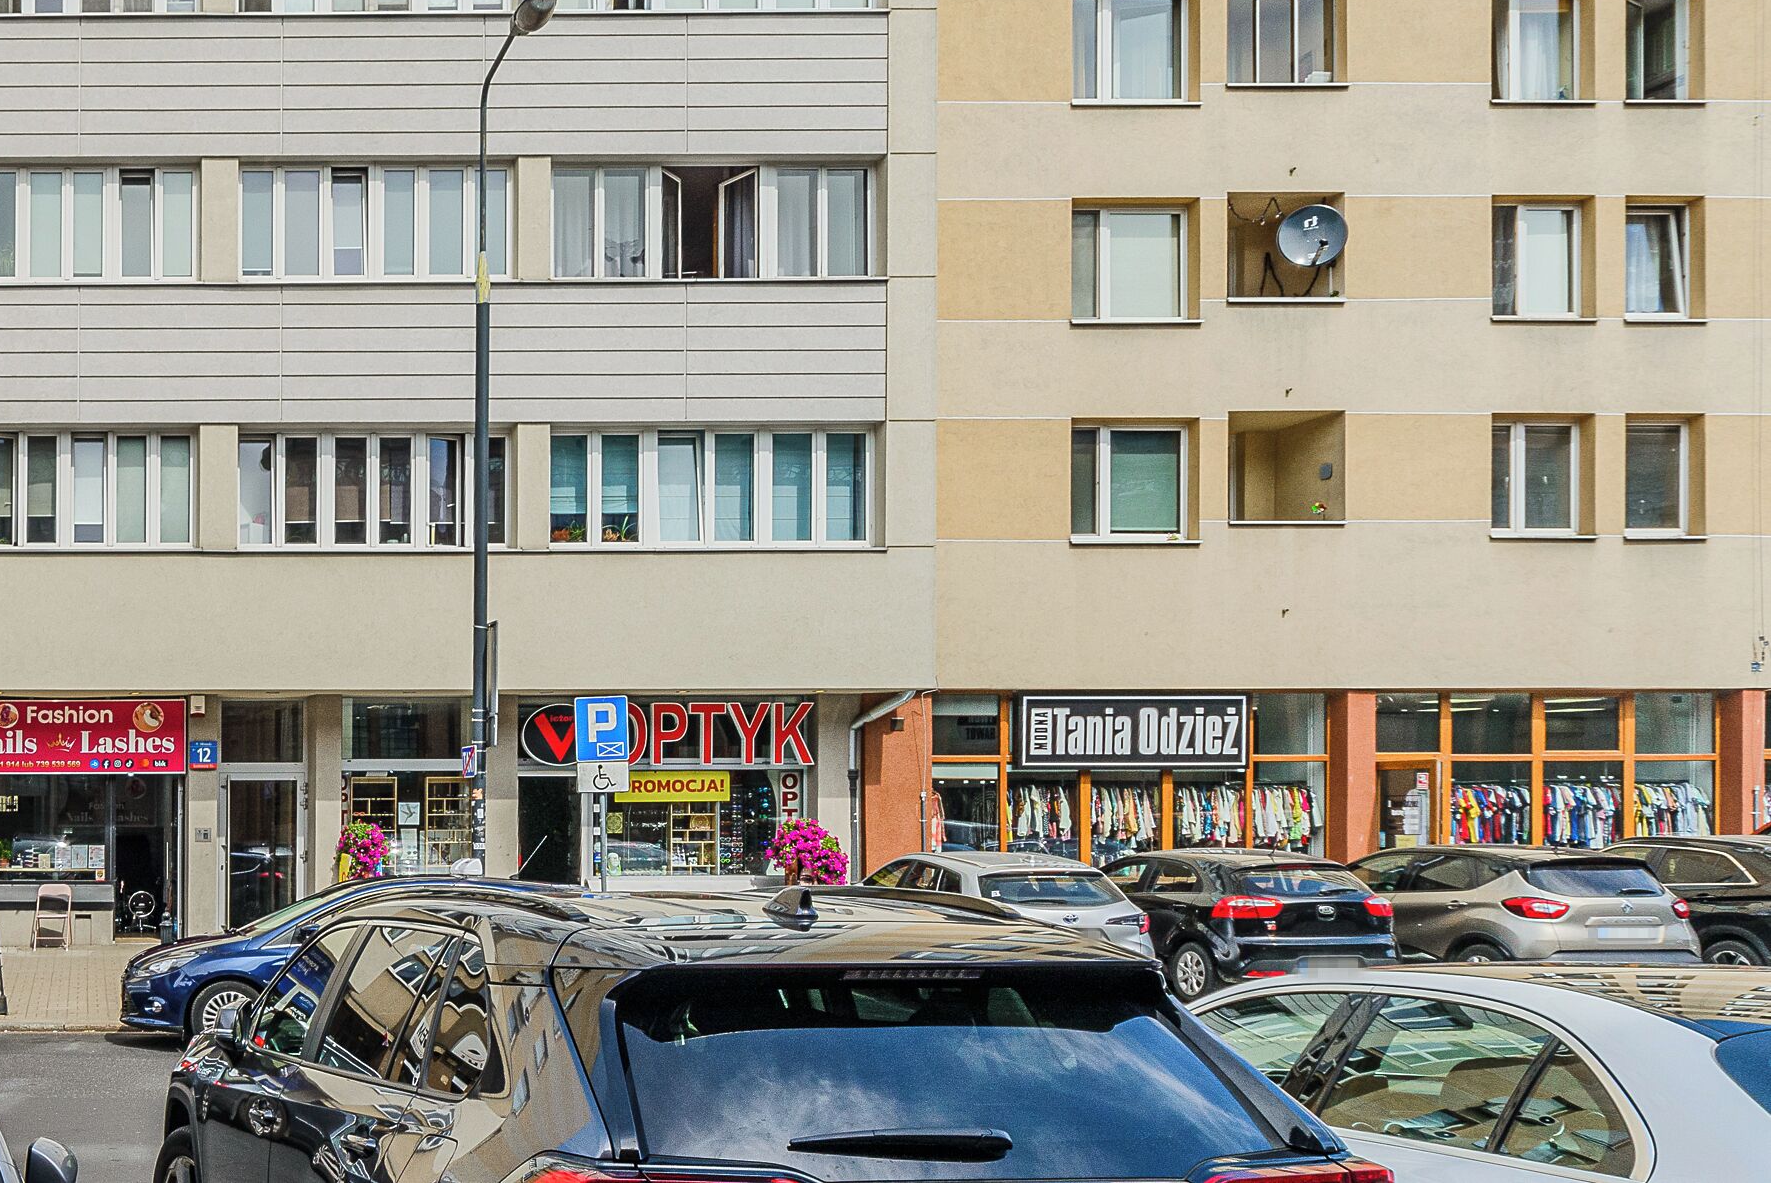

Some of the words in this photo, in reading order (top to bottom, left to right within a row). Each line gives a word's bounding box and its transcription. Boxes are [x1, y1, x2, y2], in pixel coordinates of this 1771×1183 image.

[26, 705, 113, 724] Fashion
[587, 702, 617, 743] P
[80, 729, 175, 754] Lashes
[1034, 711, 1049, 751] MODNA
[1053, 707, 1132, 755] Tania
[1138, 707, 1240, 755] Odzież
[5, 760, 20, 768] 914
[21, 760, 34, 768] lub
[36, 760, 50, 768] 739
[51, 760, 66, 768] 539
[196, 747, 211, 763] 12
[628, 779, 725, 793] ROMOCJA!
[781, 773, 799, 819] OPT
